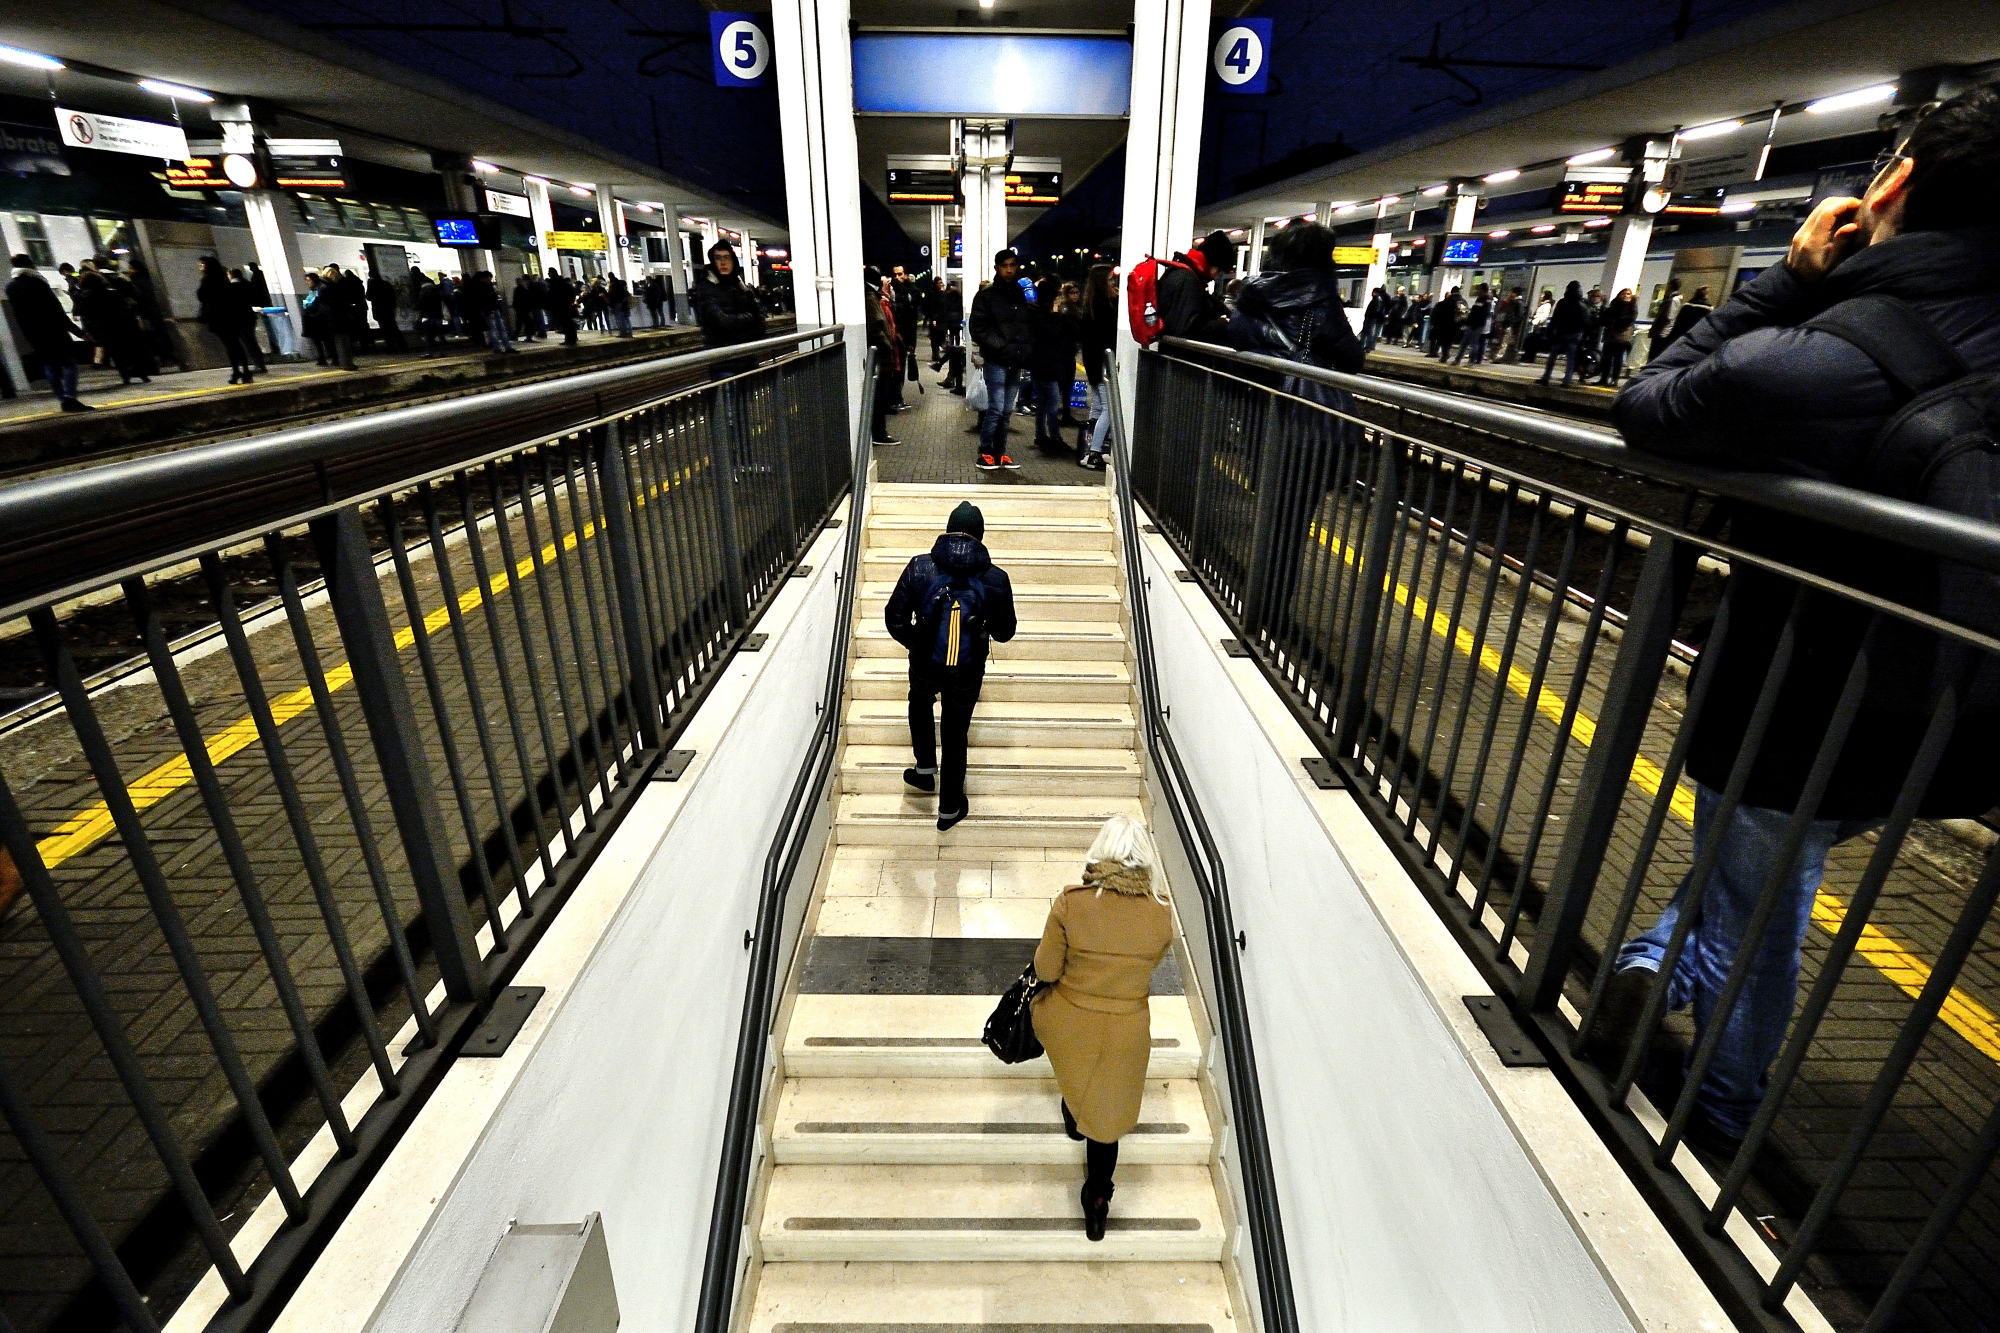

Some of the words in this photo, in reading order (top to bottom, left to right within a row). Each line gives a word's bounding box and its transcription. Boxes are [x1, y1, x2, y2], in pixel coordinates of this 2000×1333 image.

[734, 31, 757, 69] 5
[1224, 37, 1251, 75] 4
[0, 128, 61, 155] brate
[330, 158, 338, 167] 6
[890, 172, 896, 180] 5
[1052, 176, 1058, 184] 4
[1568, 184, 1575, 192] 3
[1716, 188, 1725, 197] 2
